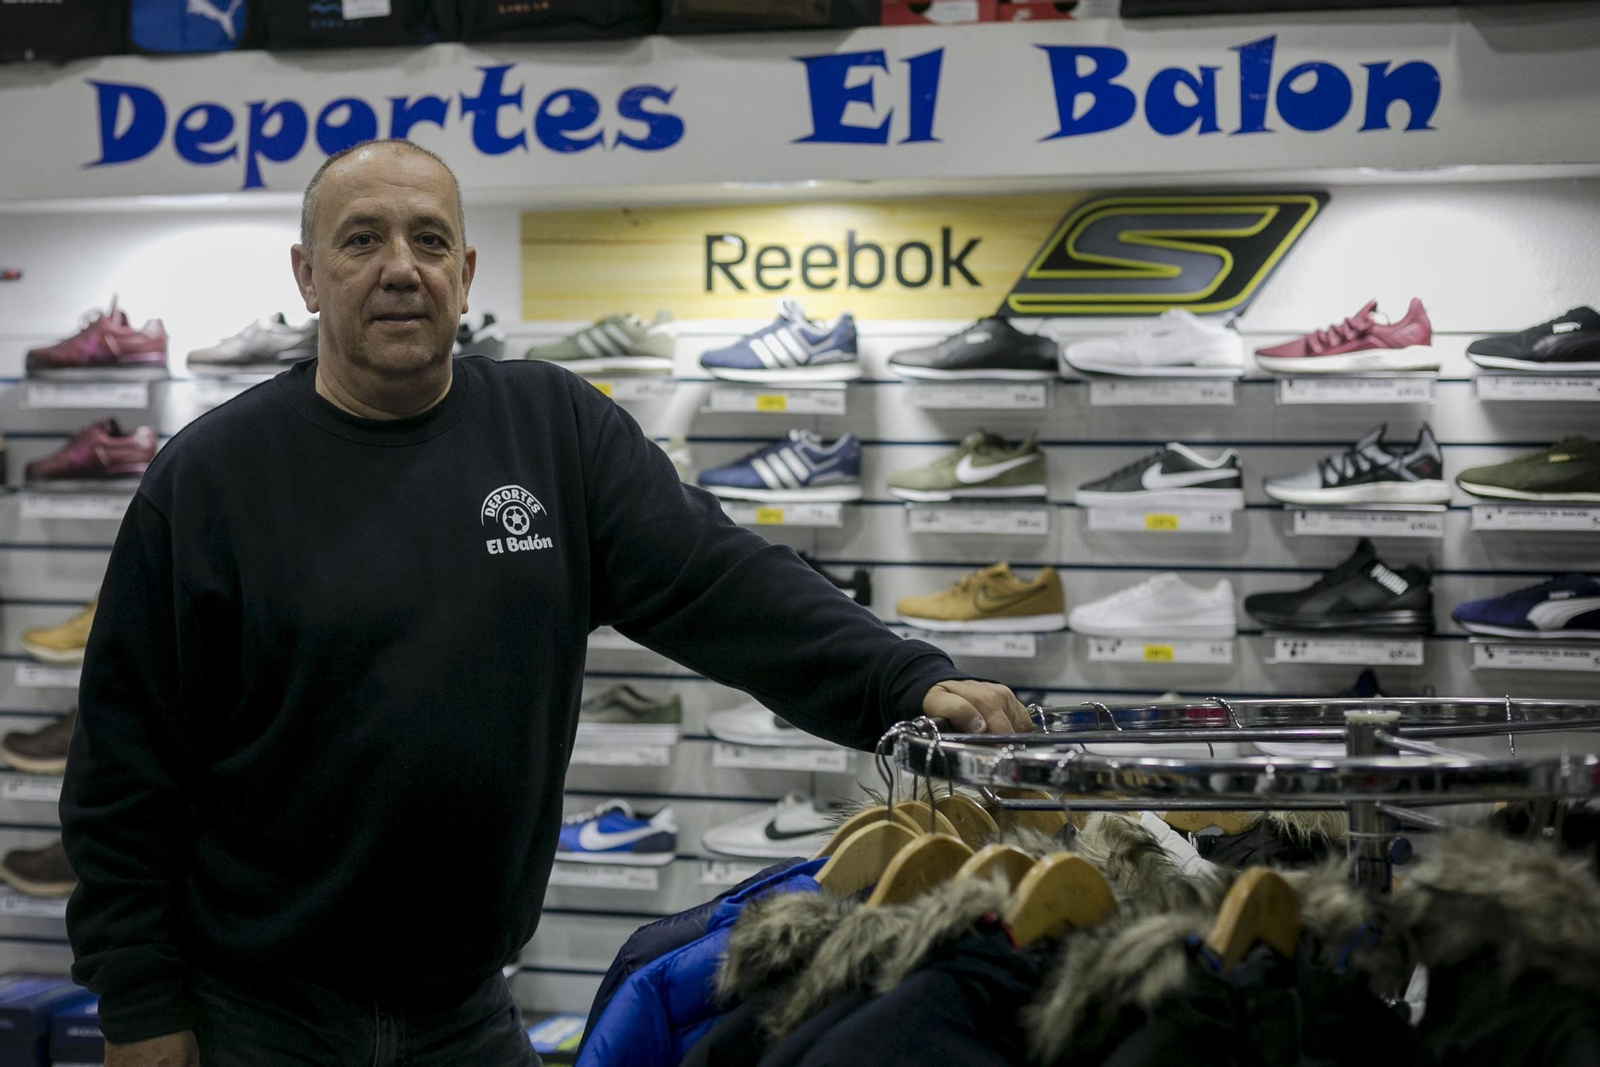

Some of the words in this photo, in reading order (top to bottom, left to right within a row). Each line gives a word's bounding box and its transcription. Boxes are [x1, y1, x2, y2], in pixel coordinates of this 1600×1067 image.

[83, 64, 685, 189] Deportes
[793, 47, 944, 146] El
[1033, 35, 1442, 142] Balon
[704, 227, 983, 292] Reebok
[484, 488, 542, 518] DEPORTES
[486, 538, 505, 555] El
[506, 533, 554, 553] Balón
